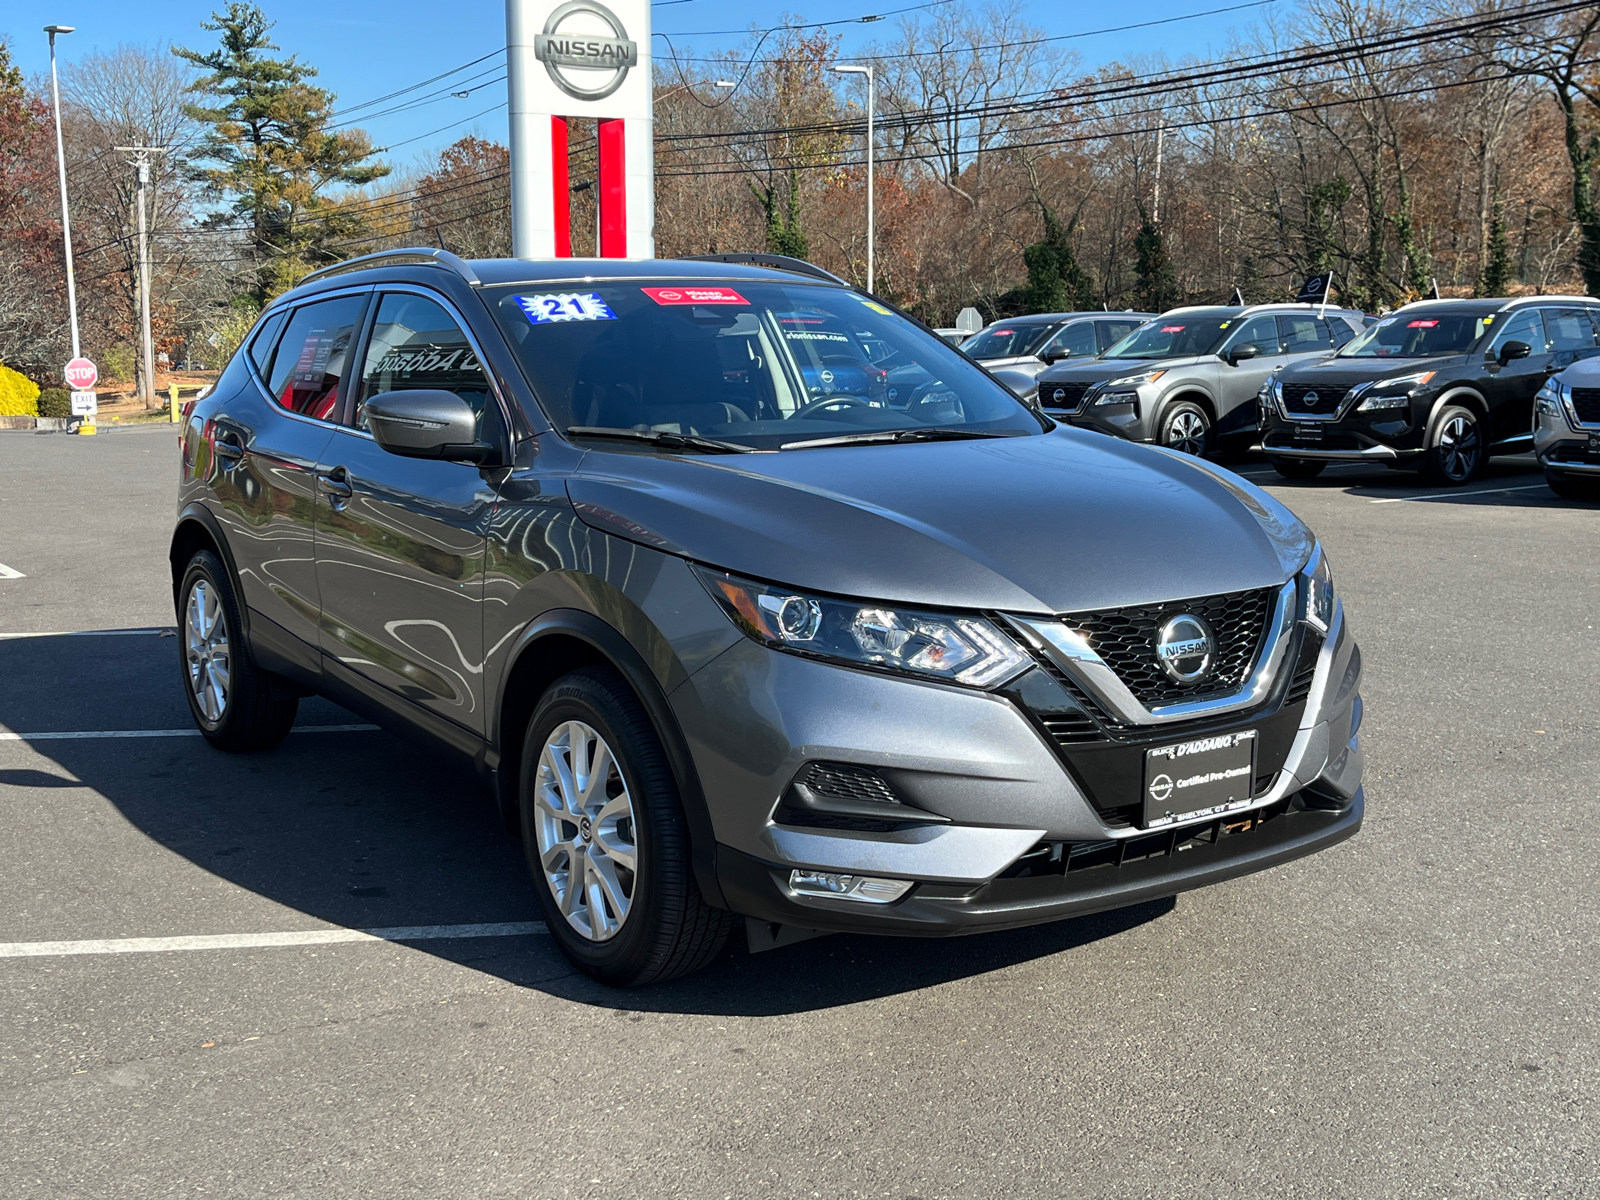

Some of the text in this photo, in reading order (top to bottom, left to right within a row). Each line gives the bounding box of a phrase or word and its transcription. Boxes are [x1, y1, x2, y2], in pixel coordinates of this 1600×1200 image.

[547, 40, 629, 59] NISSAN
[543, 298, 585, 315] 21
[68, 368, 94, 380] STOP
[75, 395, 93, 403] EXIT
[1166, 641, 1209, 656] NISSAN
[1177, 736, 1231, 756] D'ADDARIO
[1176, 765, 1251, 788] Certified Pre-Owned
[1214, 804, 1225, 813] CT
